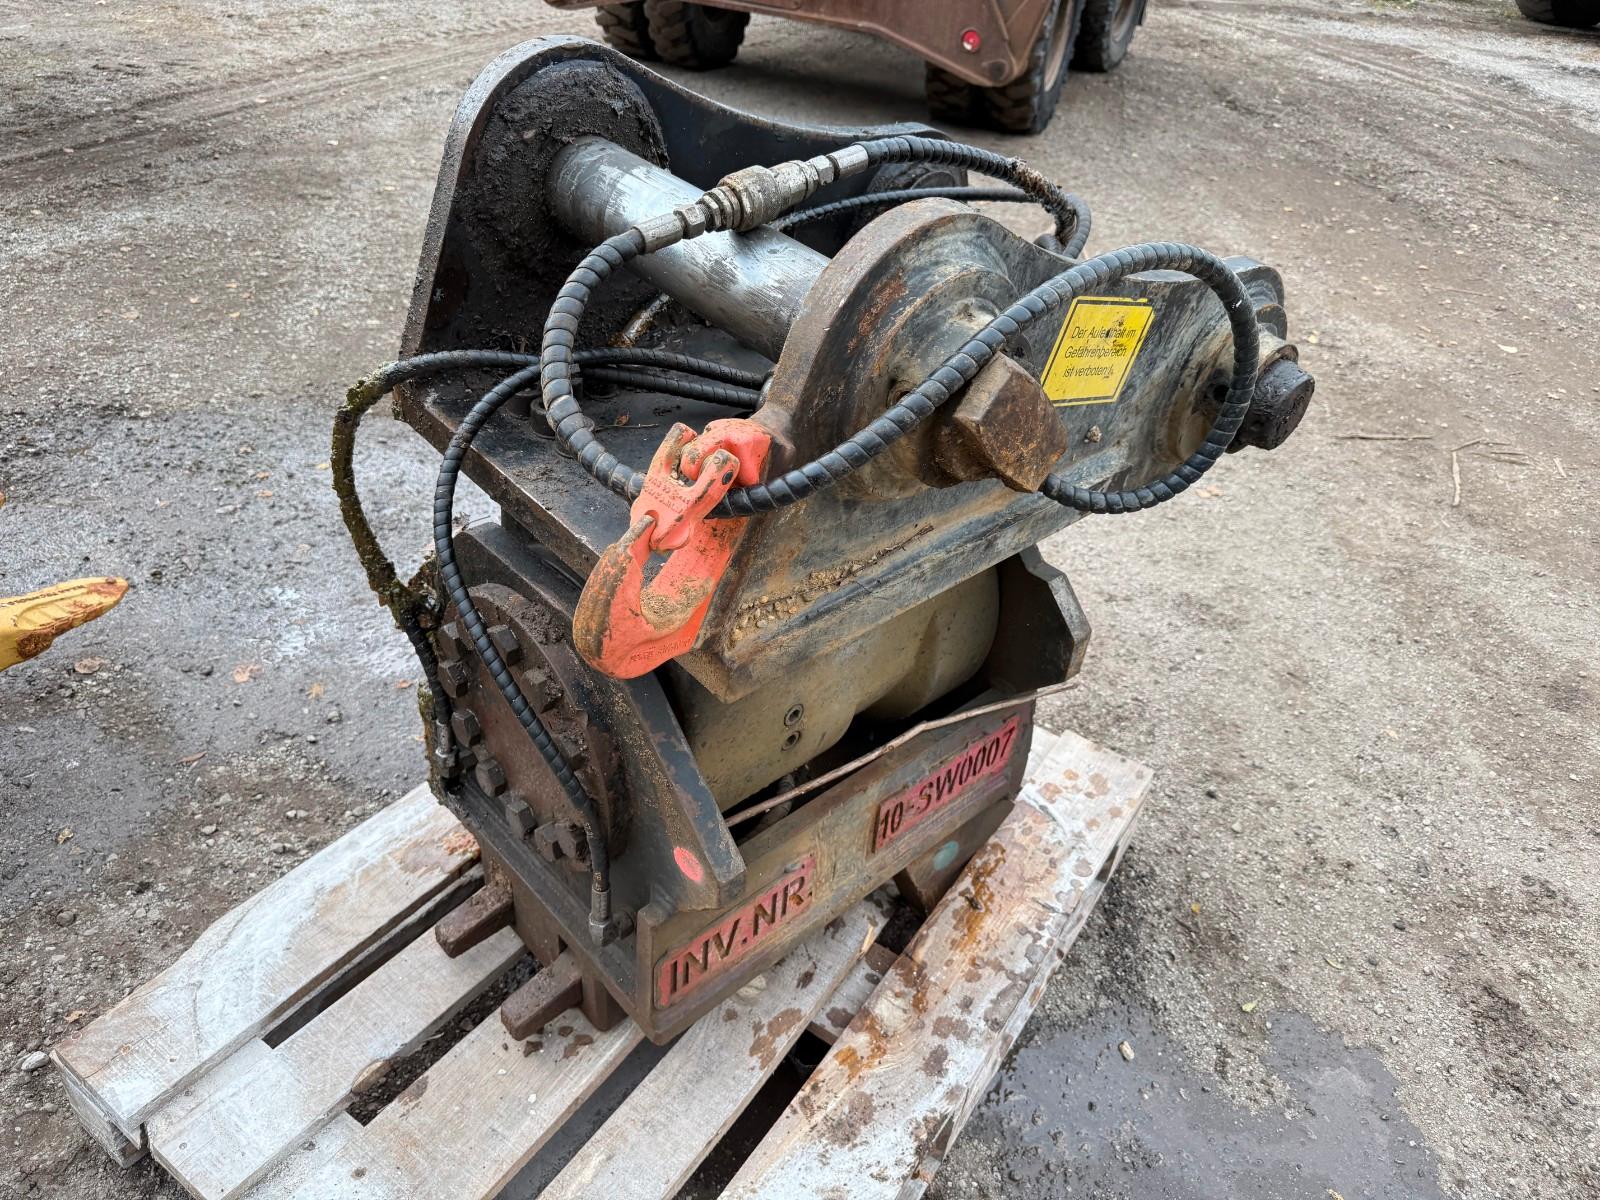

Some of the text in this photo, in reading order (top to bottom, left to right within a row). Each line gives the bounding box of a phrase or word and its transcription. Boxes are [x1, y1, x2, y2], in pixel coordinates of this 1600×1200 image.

[1071, 326, 1087, 339] Der
[1125, 327, 1137, 339] im
[1064, 345, 1127, 359] Gefahrenbereich
[1063, 365, 1075, 378] ist
[879, 725, 1016, 840] 10-SW0007
